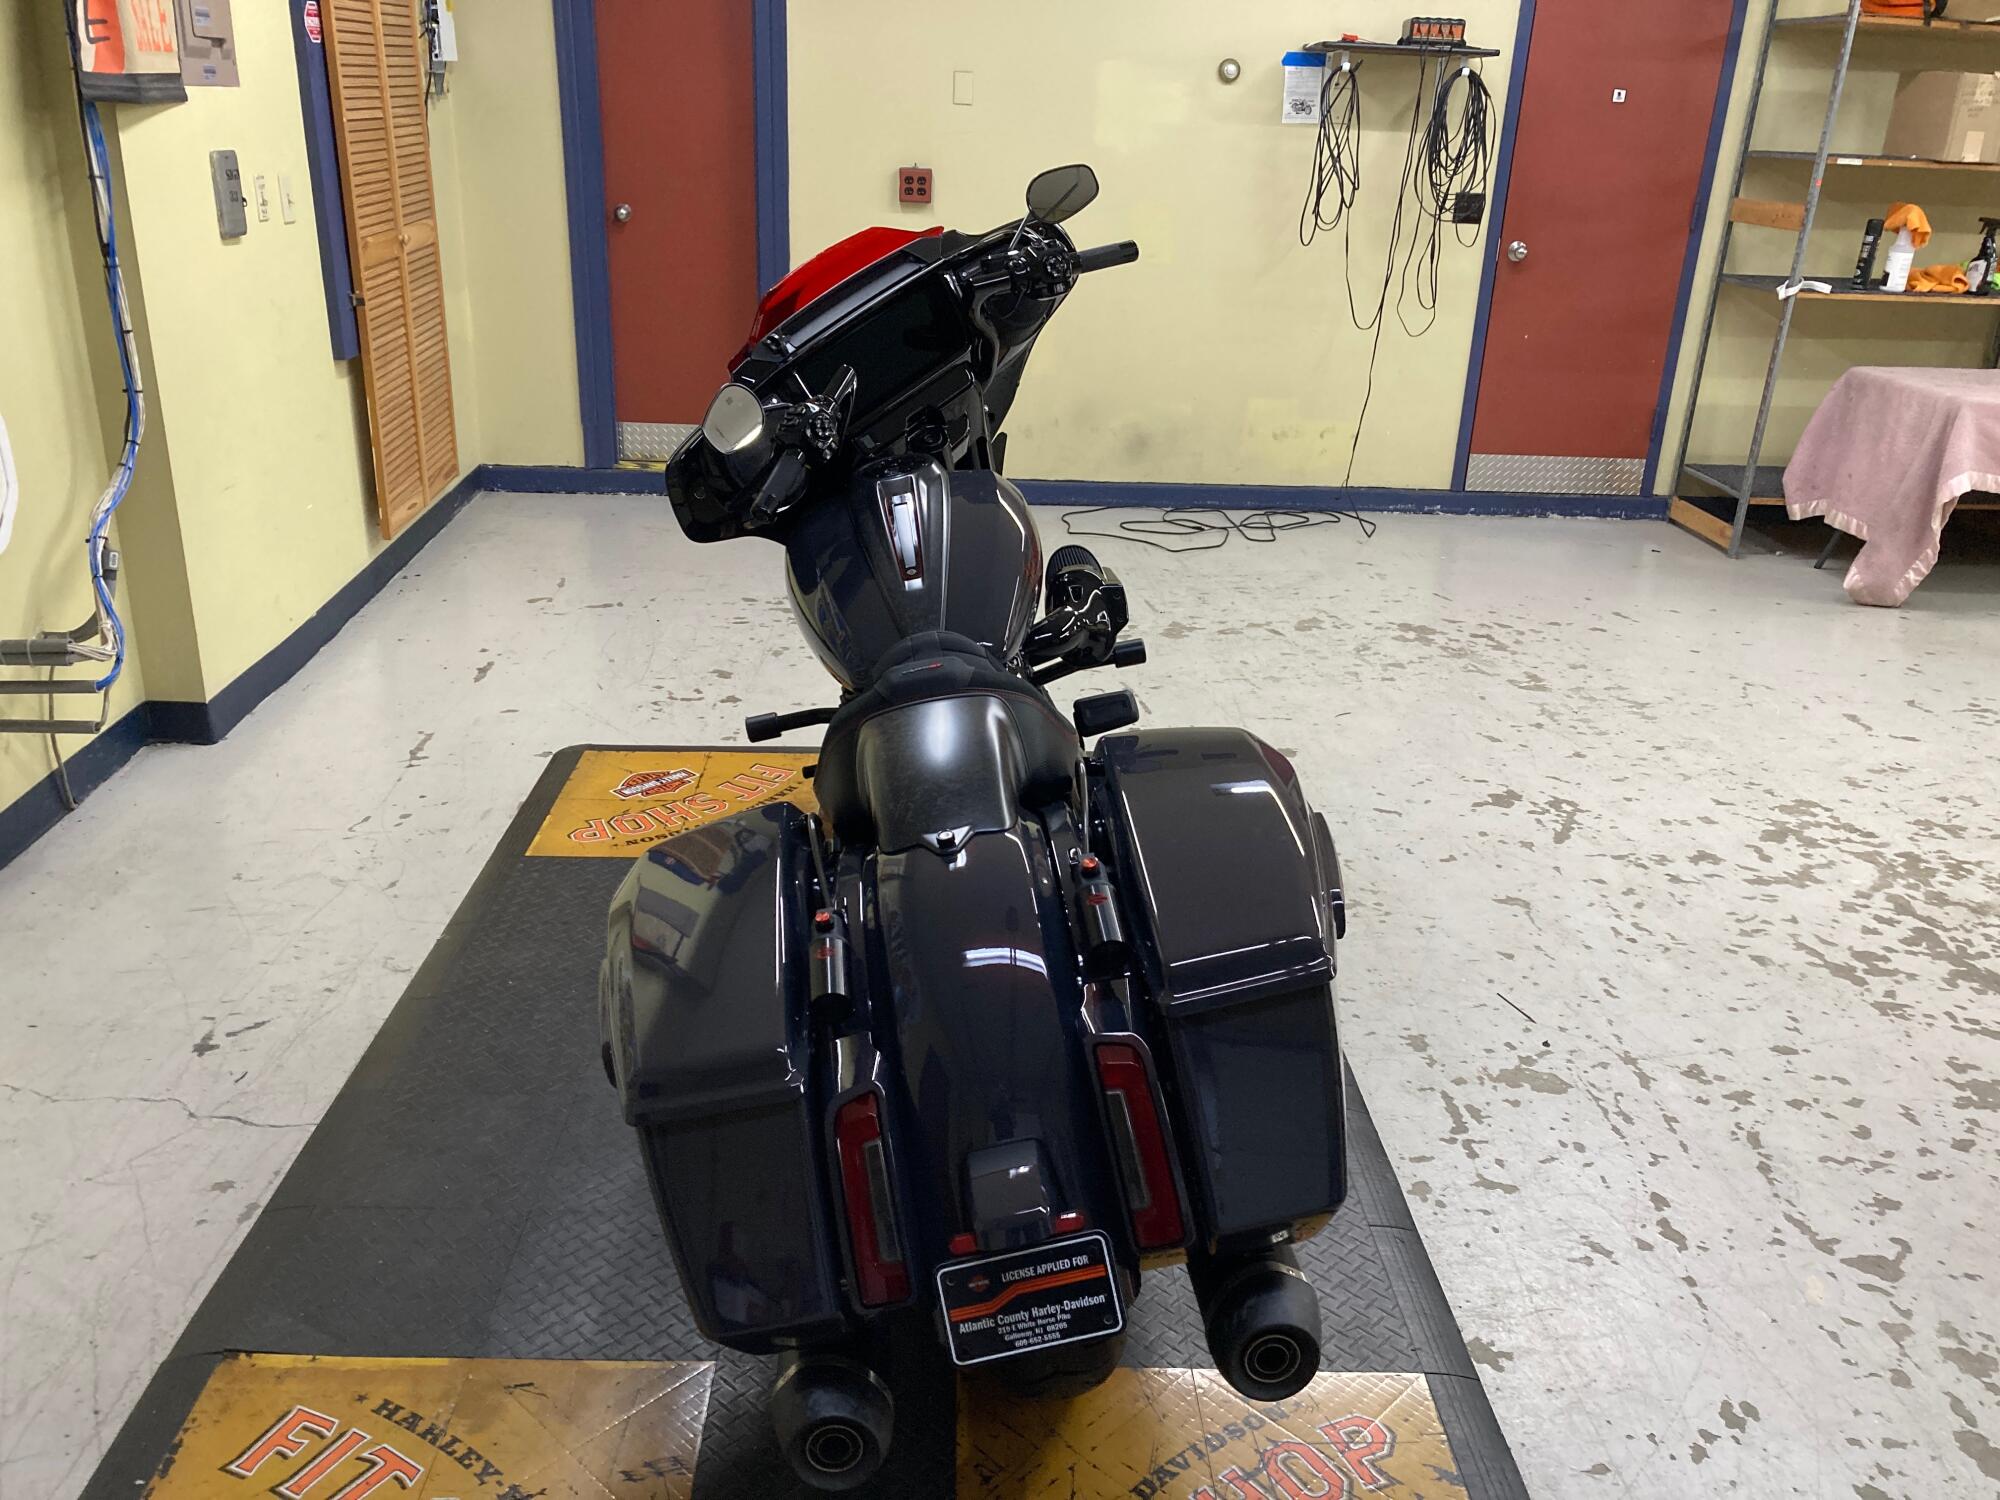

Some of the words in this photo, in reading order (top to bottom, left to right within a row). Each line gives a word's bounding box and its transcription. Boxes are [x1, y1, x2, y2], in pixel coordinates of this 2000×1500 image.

[718, 763, 797, 801] FIT
[569, 793, 729, 843] SHOP
[1001, 1266, 1036, 1282] LICENSE
[1037, 1259, 1071, 1275] APPLIED
[1072, 1254, 1090, 1267] FOR
[959, 1317, 995, 1334] Atlantic
[997, 1309, 1029, 1325] County
[1031, 1294, 1106, 1317] Harley-Davidson
[1017, 1320, 1035, 1330] White
[228, 1405, 425, 1500] FIT
